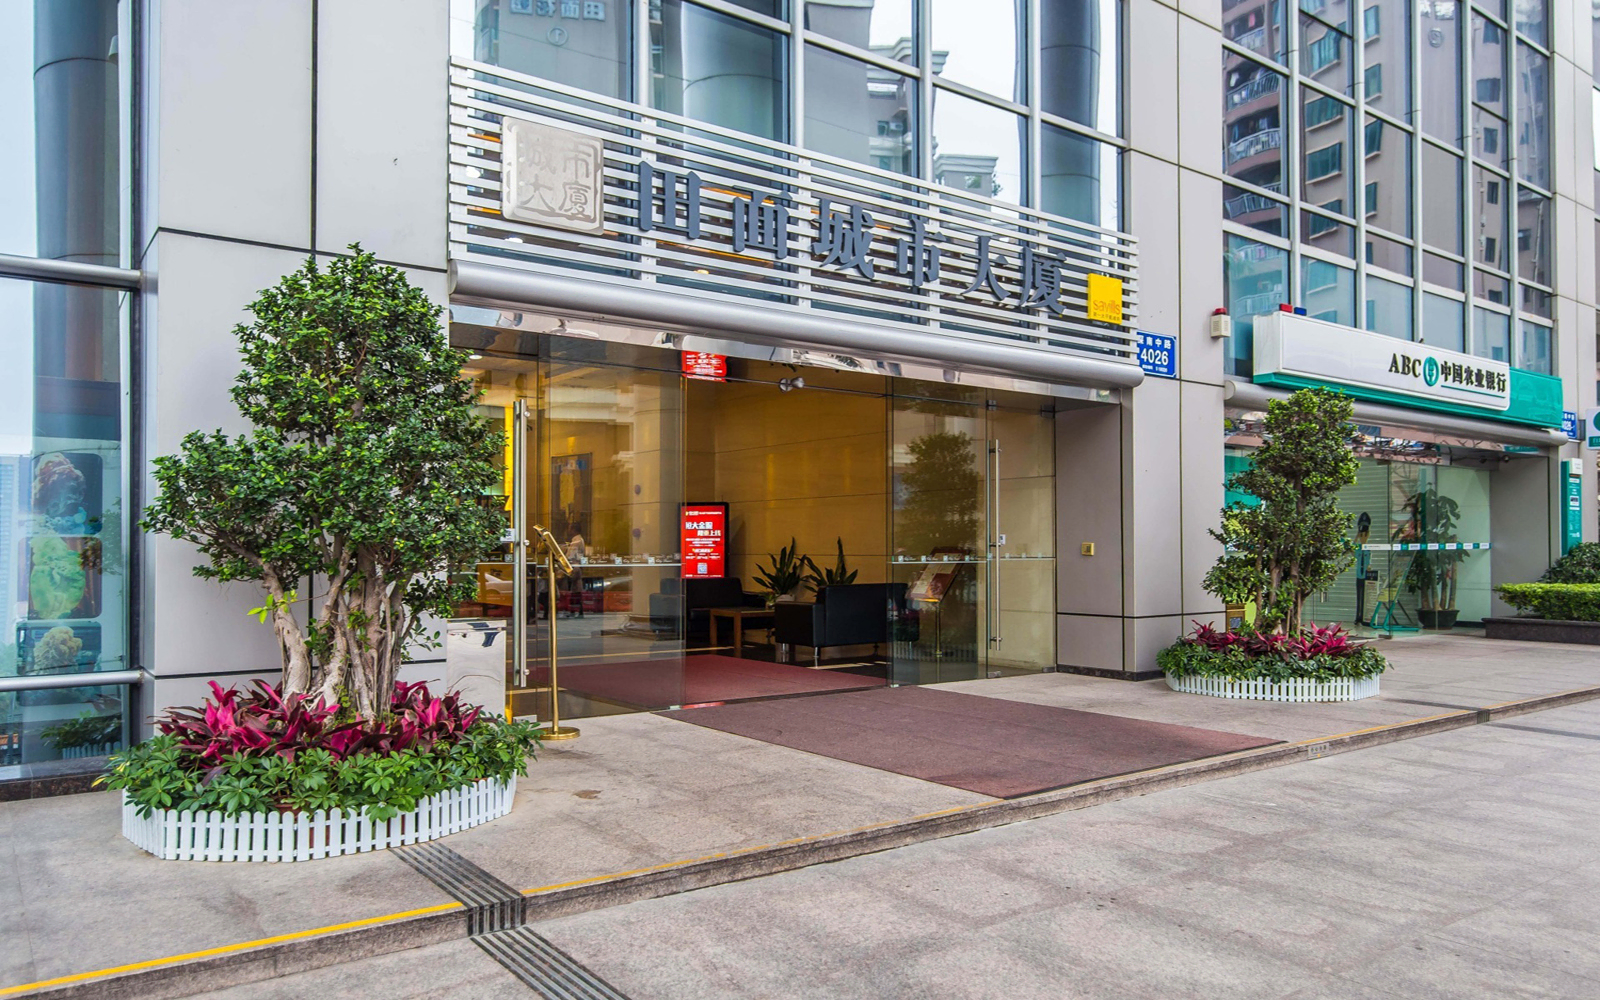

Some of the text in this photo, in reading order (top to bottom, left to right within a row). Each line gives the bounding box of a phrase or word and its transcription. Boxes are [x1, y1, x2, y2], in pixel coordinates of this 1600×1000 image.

[638, 160, 1067, 315] 田面城市大厦
[1093, 299, 1121, 315] savills
[1140, 348, 1169, 366] 4026
[1388, 352, 1422, 378] ABC
[1440, 360, 1507, 393] 中国农业银行
